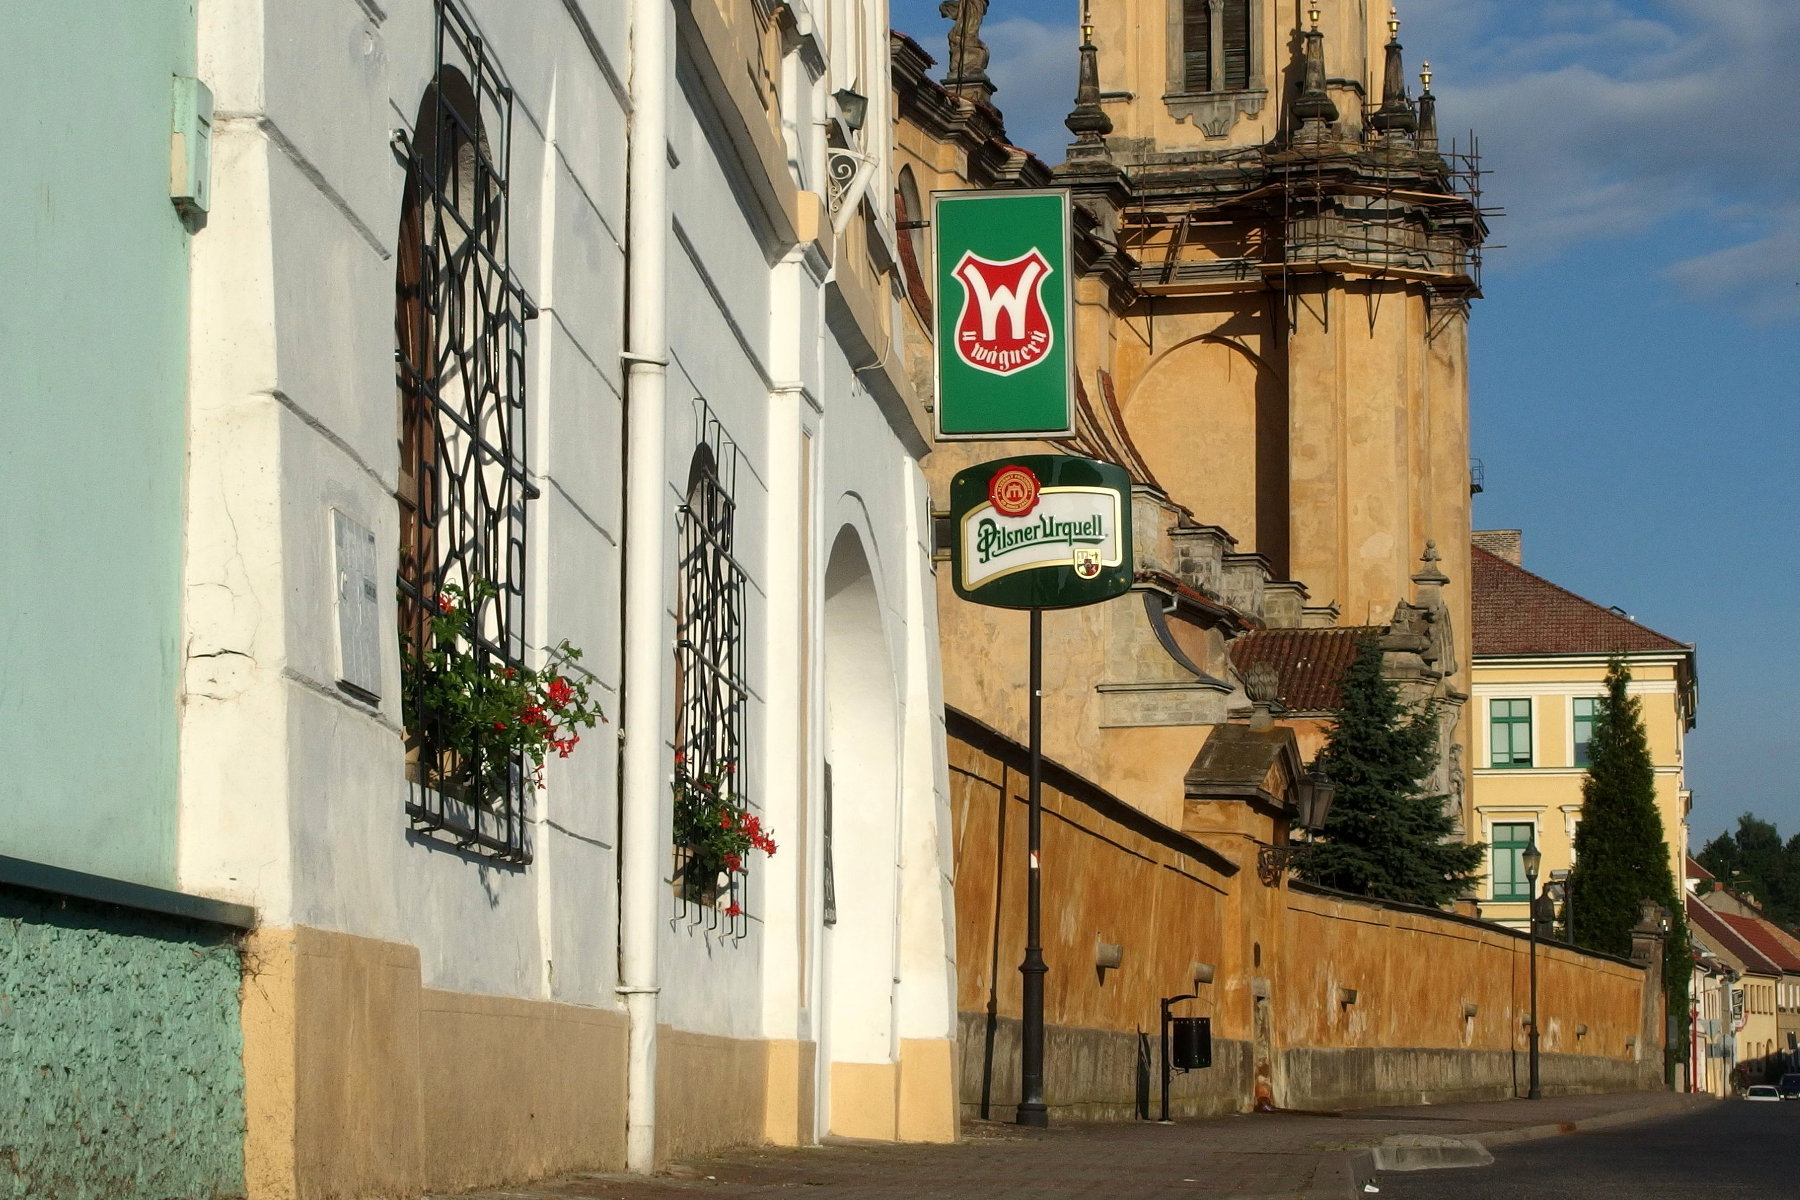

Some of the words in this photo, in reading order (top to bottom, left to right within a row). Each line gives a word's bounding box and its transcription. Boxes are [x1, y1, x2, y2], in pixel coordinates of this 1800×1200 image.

[963, 261, 1041, 341] W
[977, 517, 1040, 564] Pilsner
[1040, 513, 1102, 546] Urquell
